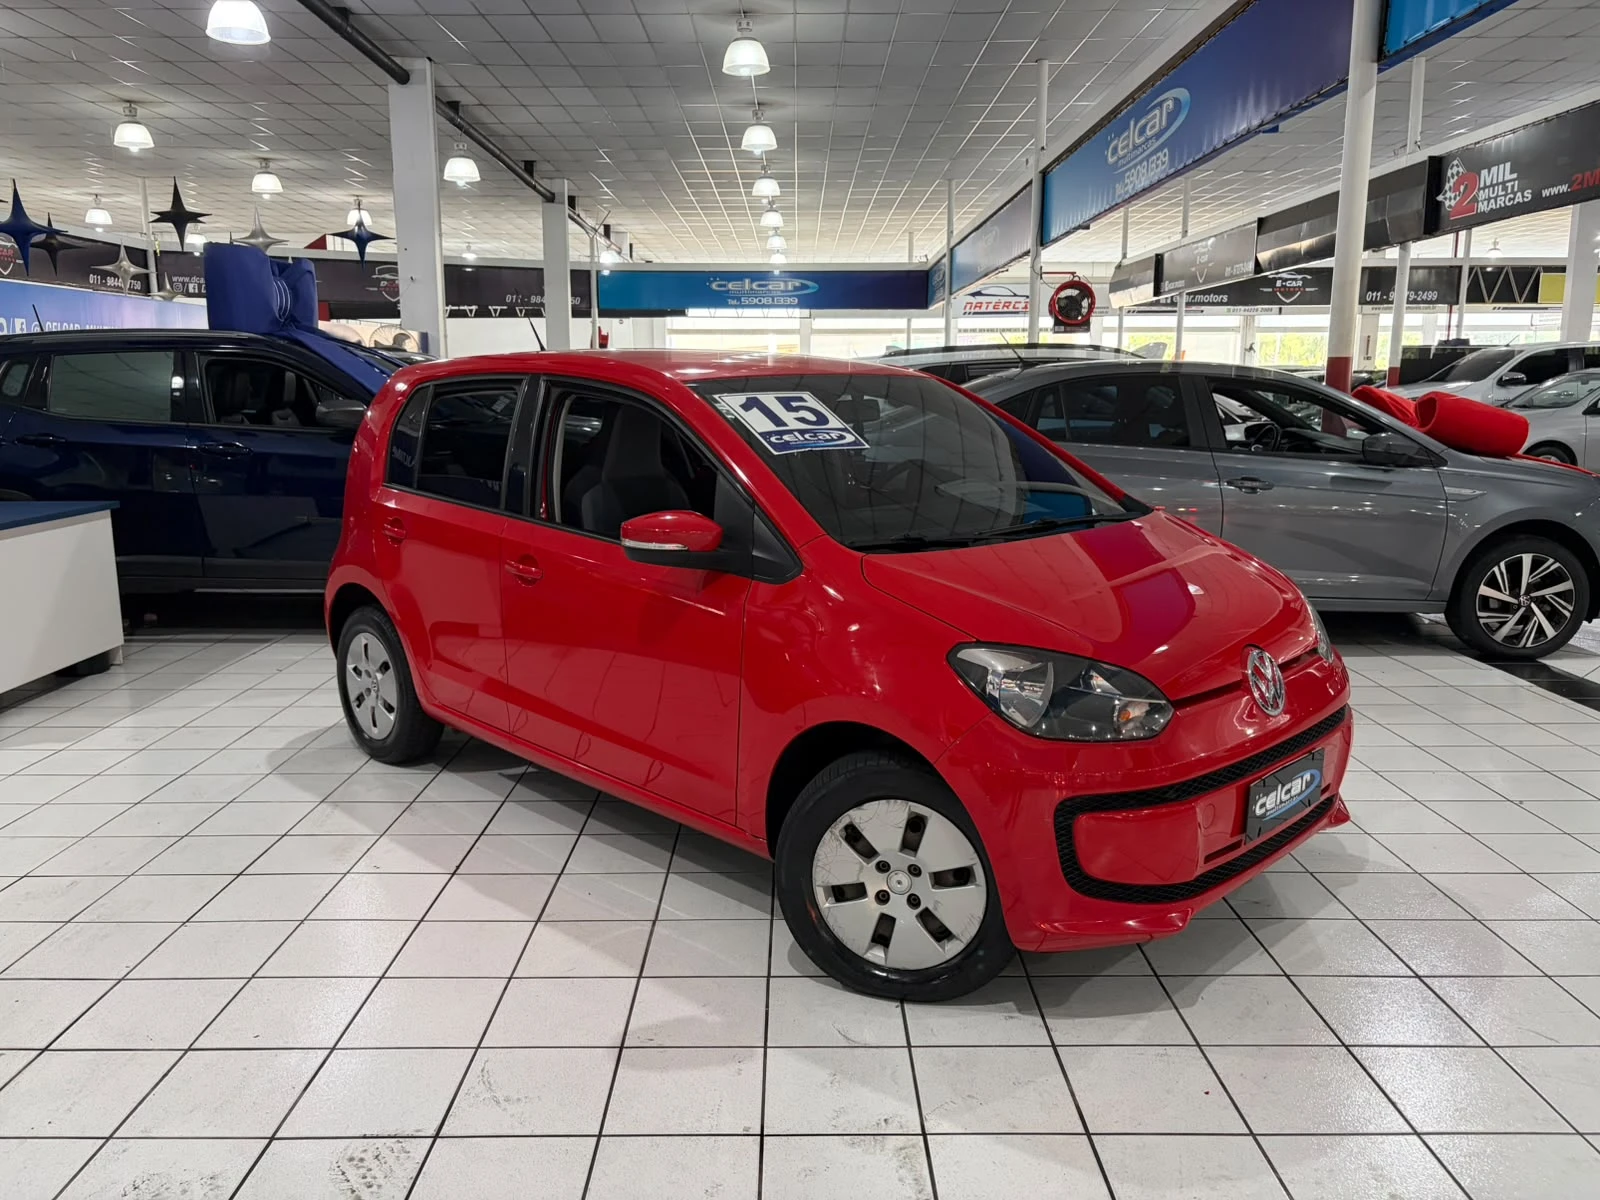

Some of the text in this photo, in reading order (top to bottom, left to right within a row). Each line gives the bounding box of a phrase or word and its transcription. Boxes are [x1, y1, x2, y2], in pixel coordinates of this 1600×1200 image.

[1106, 98, 1175, 165] celcar
[1479, 161, 1518, 188] MIL
[1477, 188, 1533, 214] MARCAS
[1478, 181, 1519, 201] MULTI
[711, 279, 801, 291] celcar
[1366, 291, 1381, 301] 011
[738, 396, 830, 428] 15
[769, 431, 841, 443] celcar
[1255, 772, 1311, 816] celcar
